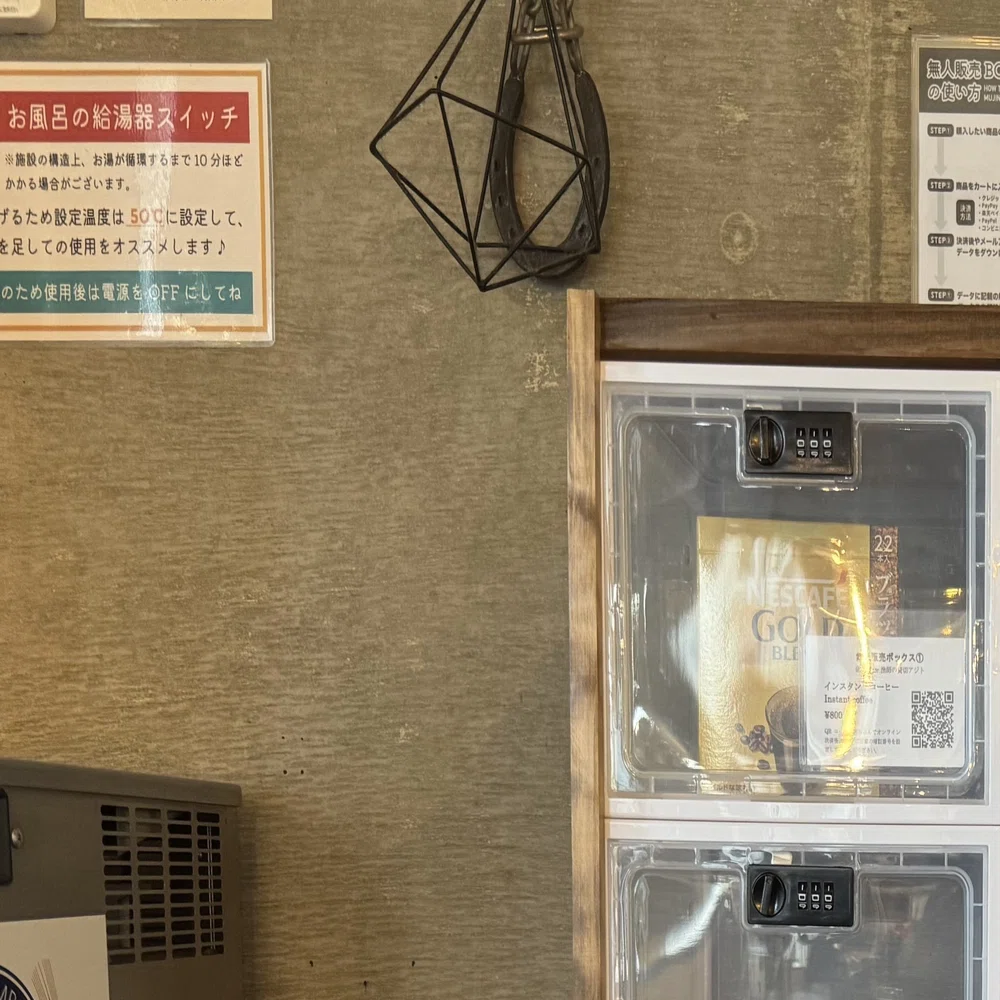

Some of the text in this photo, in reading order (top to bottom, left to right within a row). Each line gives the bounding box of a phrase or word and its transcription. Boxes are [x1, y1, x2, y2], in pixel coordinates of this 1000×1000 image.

[928, 82, 981, 102] の使い方
[984, 94, 1000, 102] MUJIN
[8, 104, 239, 131] お風呂の給湯器スイッチ
[5, 177, 131, 192] かかる場合がございます。
[874, 535, 893, 553] 22
[824, 710, 842, 720] ¥800
